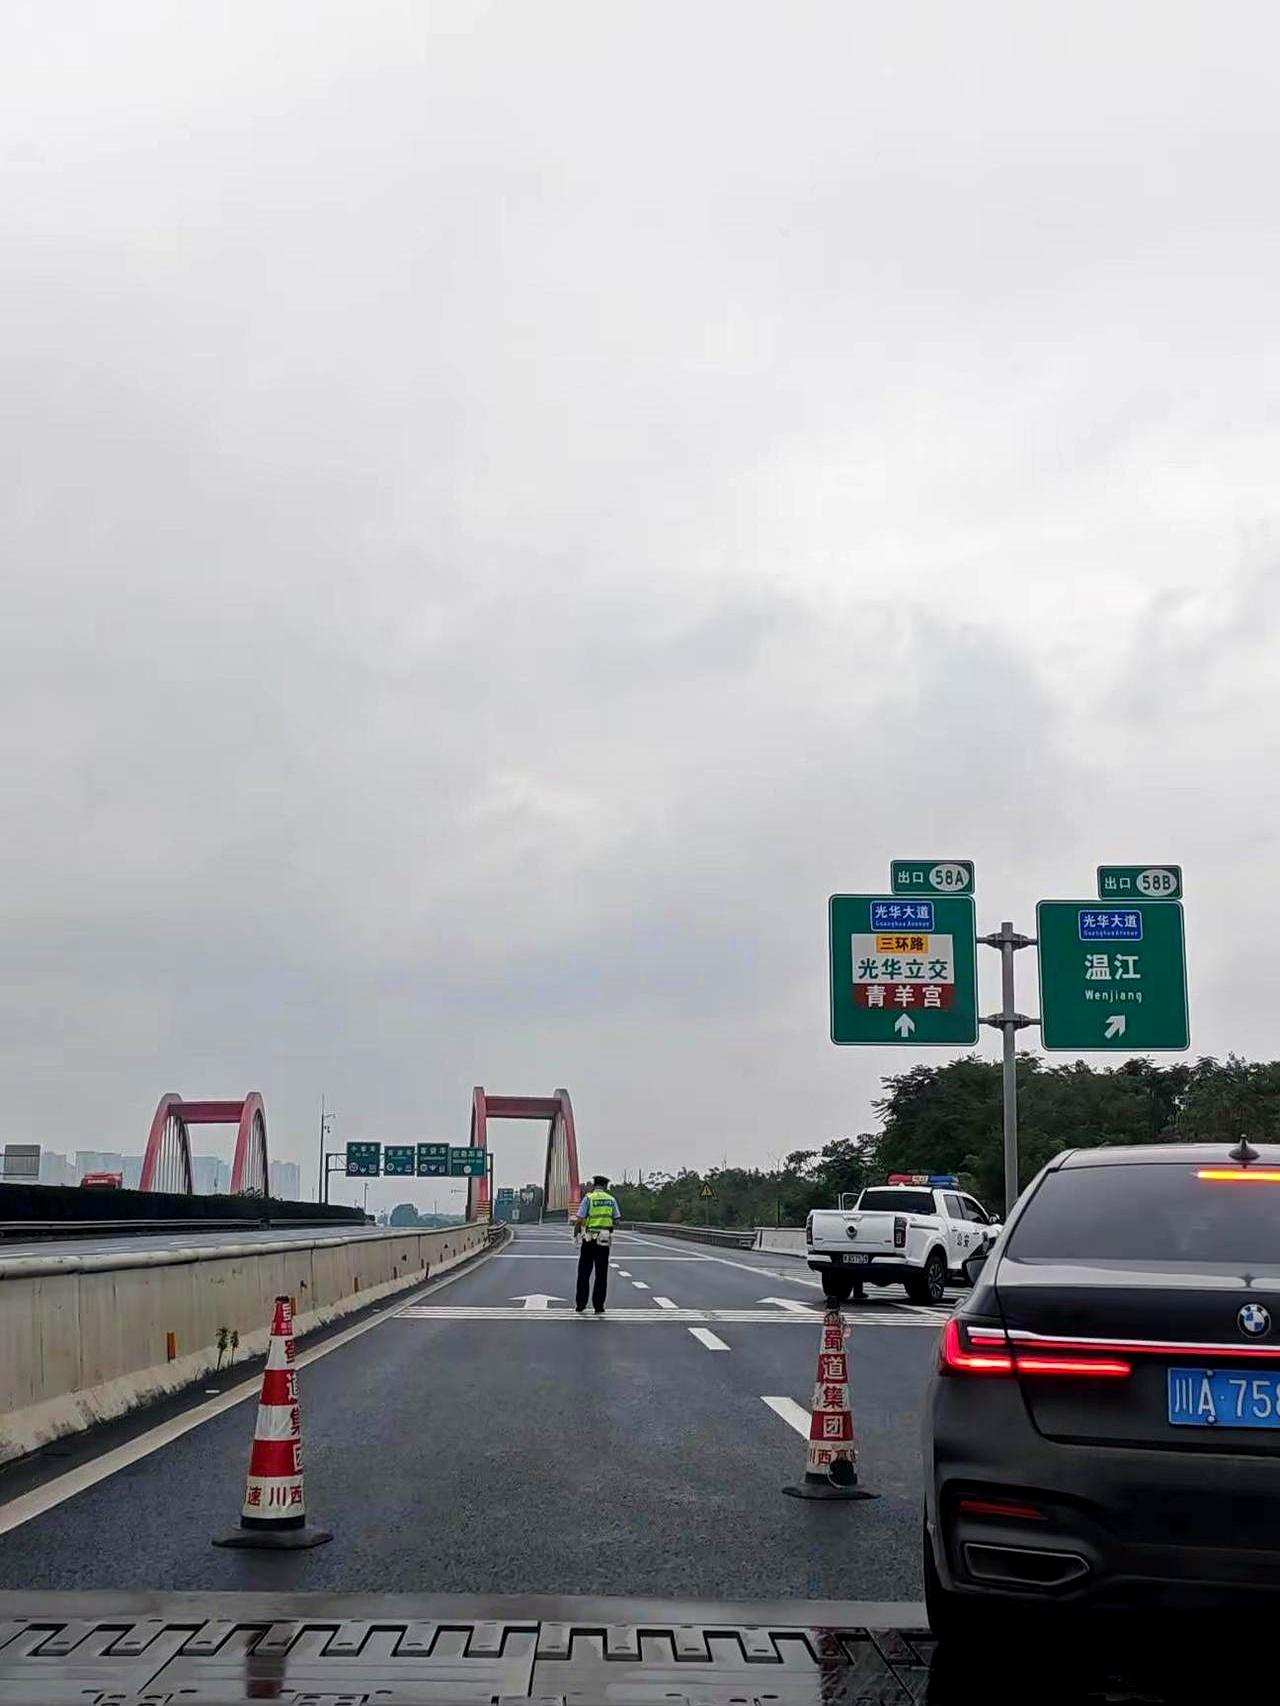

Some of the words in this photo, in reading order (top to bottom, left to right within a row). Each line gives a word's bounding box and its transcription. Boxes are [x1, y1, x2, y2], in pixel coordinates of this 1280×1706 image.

[898, 870, 924, 884] 出口
[934, 870, 965, 885] 58A
[1104, 876, 1131, 890] 出口
[1142, 875, 1171, 890] 58B
[875, 904, 930, 919] 光华大道
[1083, 914, 1138, 928] 光华大道
[880, 936, 924, 951] 三环路
[857, 957, 948, 980] 光华立交
[1084, 953, 1142, 981] 温江
[865, 985, 942, 1008] 青羊宫
[1085, 989, 1143, 1003] Wenjiang
[1175, 1377, 1280, 1418] 川A·75
